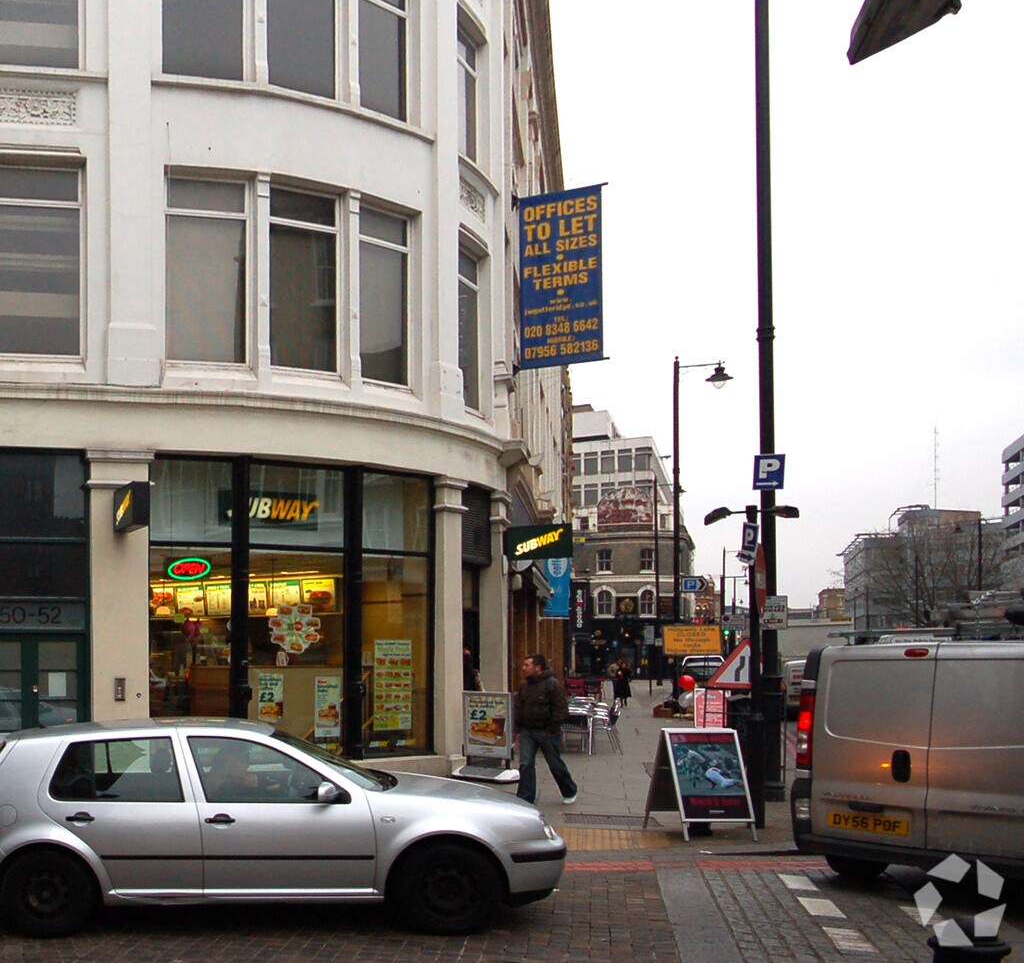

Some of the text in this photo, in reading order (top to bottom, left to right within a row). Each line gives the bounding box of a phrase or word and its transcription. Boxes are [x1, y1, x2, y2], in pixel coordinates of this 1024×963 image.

[523, 195, 598, 222] OFFICES
[524, 214, 598, 243] TO LET
[524, 234, 598, 257] ALL SIZES
[523, 256, 598, 279] FLEXIBLE
[533, 271, 589, 291] TERMS
[524, 325, 543, 339] 020
[545, 321, 571, 336] 8348
[524, 344, 557, 360] 07956
[758, 458, 781, 479] P
[225, 496, 321, 521] UBWAY
[514, 527, 564, 556] SUBWAY
[173, 562, 207, 575] OPEN
[686, 580, 695, 589] P
[0, 606, 62, 624] 50-52
[259, 692, 275, 703] £2
[469, 709, 487, 720] £2
[832, 813, 903, 832] DY56 POF
